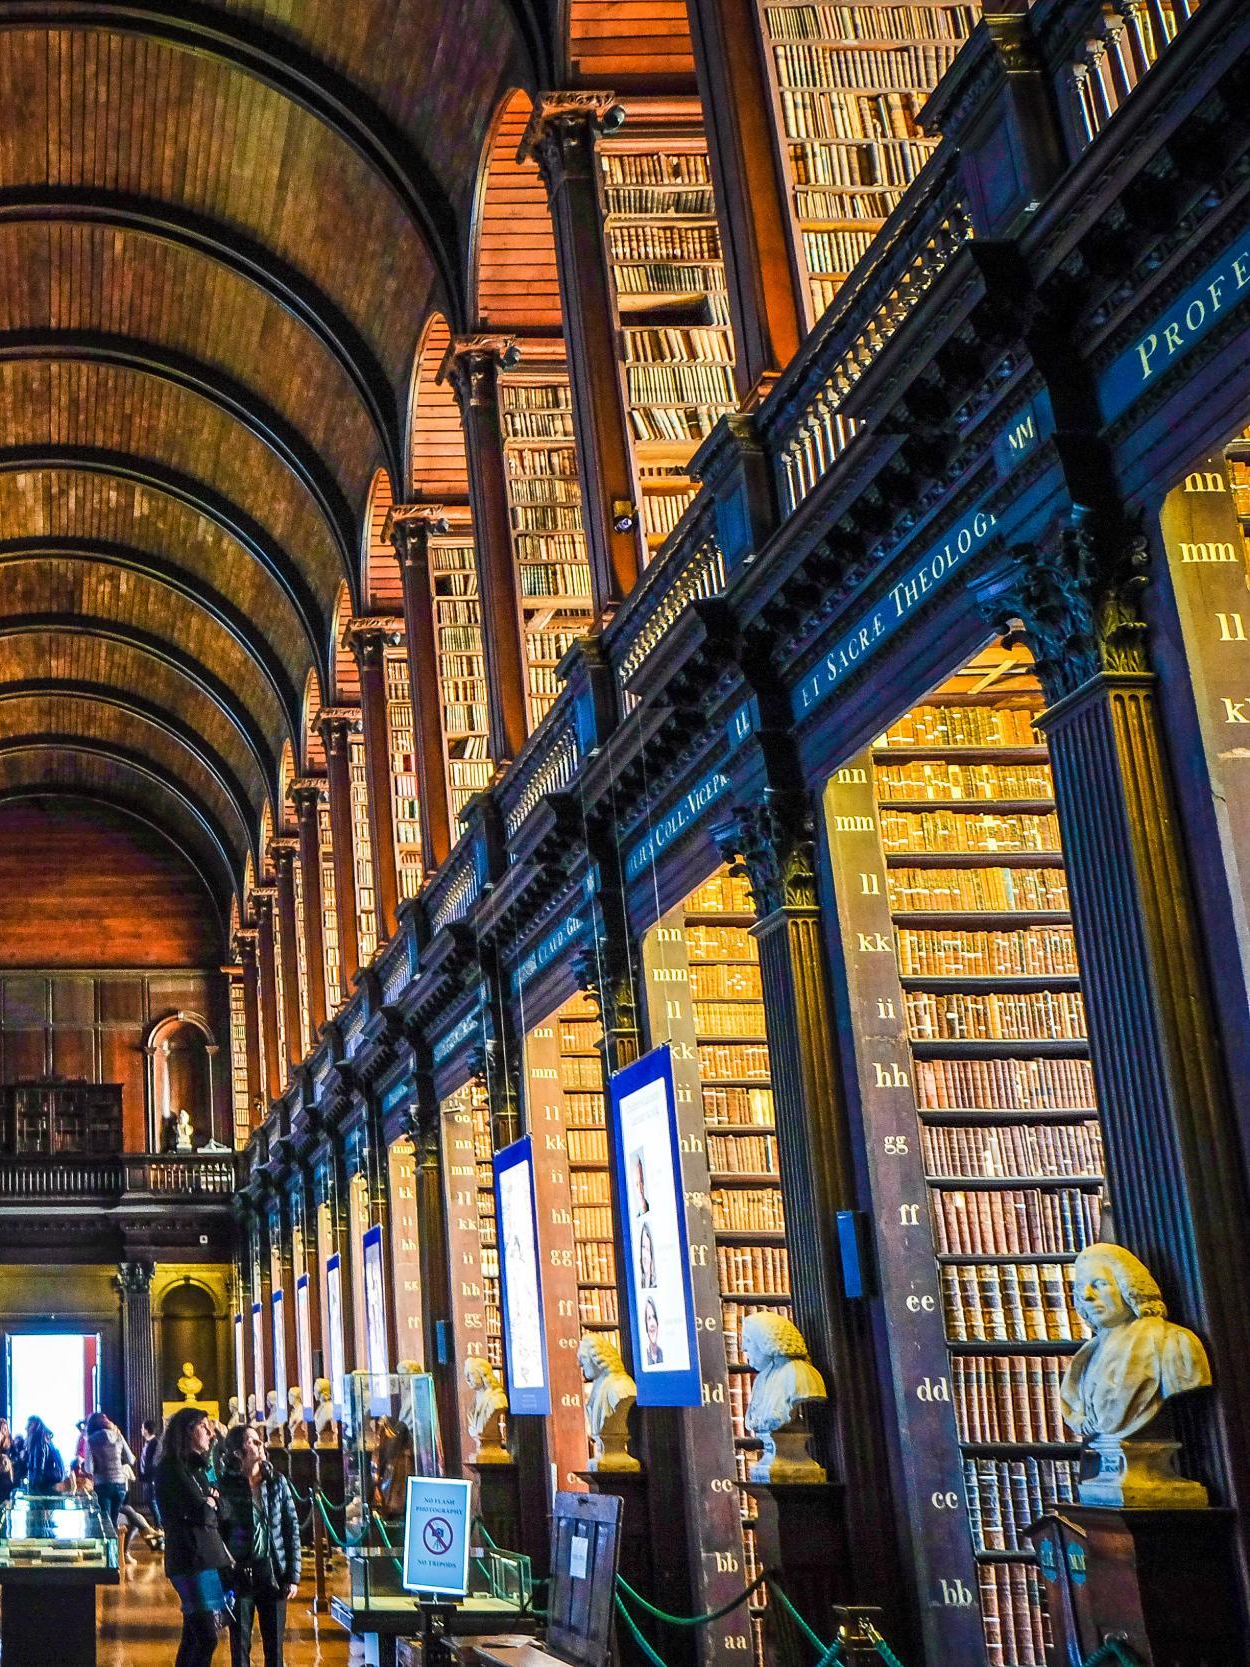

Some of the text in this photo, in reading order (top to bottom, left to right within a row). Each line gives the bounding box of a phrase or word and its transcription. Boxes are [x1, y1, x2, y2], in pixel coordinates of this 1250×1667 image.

[1135, 252, 1250, 380] PROFE
[1184, 471, 1226, 492] nn
[1179, 541, 1238, 562] mm
[1215, 612, 1247, 641] ll
[802, 675, 820, 707] ET
[1220, 697, 1250, 723] k
[837, 768, 867, 784] nn
[834, 815, 875, 832] mm
[859, 873, 880, 895] ll
[656, 928, 682, 941] nn
[857, 933, 892, 952] kk
[653, 968, 688, 982] mm
[667, 1000, 681, 1019] ll
[876, 998, 895, 1019] ii
[534, 1028, 553, 1038] nn
[531, 1068, 558, 1079] mm
[872, 1063, 910, 1088] hh
[677, 1083, 692, 1102] ii
[455, 1140, 472, 1149] nn
[545, 1135, 566, 1150] kk
[884, 1135, 909, 1155] gg
[452, 1166, 474, 1175] mm
[551, 1170, 564, 1184] ii
[552, 1209, 571, 1224] hh
[900, 1204, 920, 1225] ff
[459, 1218, 477, 1230] kk
[550, 1249, 573, 1267] gg
[462, 1283, 480, 1296] hh
[558, 1300, 573, 1316] ff
[906, 1294, 935, 1312] ee
[558, 1337, 577, 1348] ee
[916, 1377, 950, 1402] dd
[561, 1393, 581, 1407] dd
[711, 1479, 733, 1492] cc
[931, 1491, 958, 1509] cc
[716, 1552, 738, 1573] bb
[939, 1579, 973, 1606] bb
[724, 1636, 747, 1649] aa
